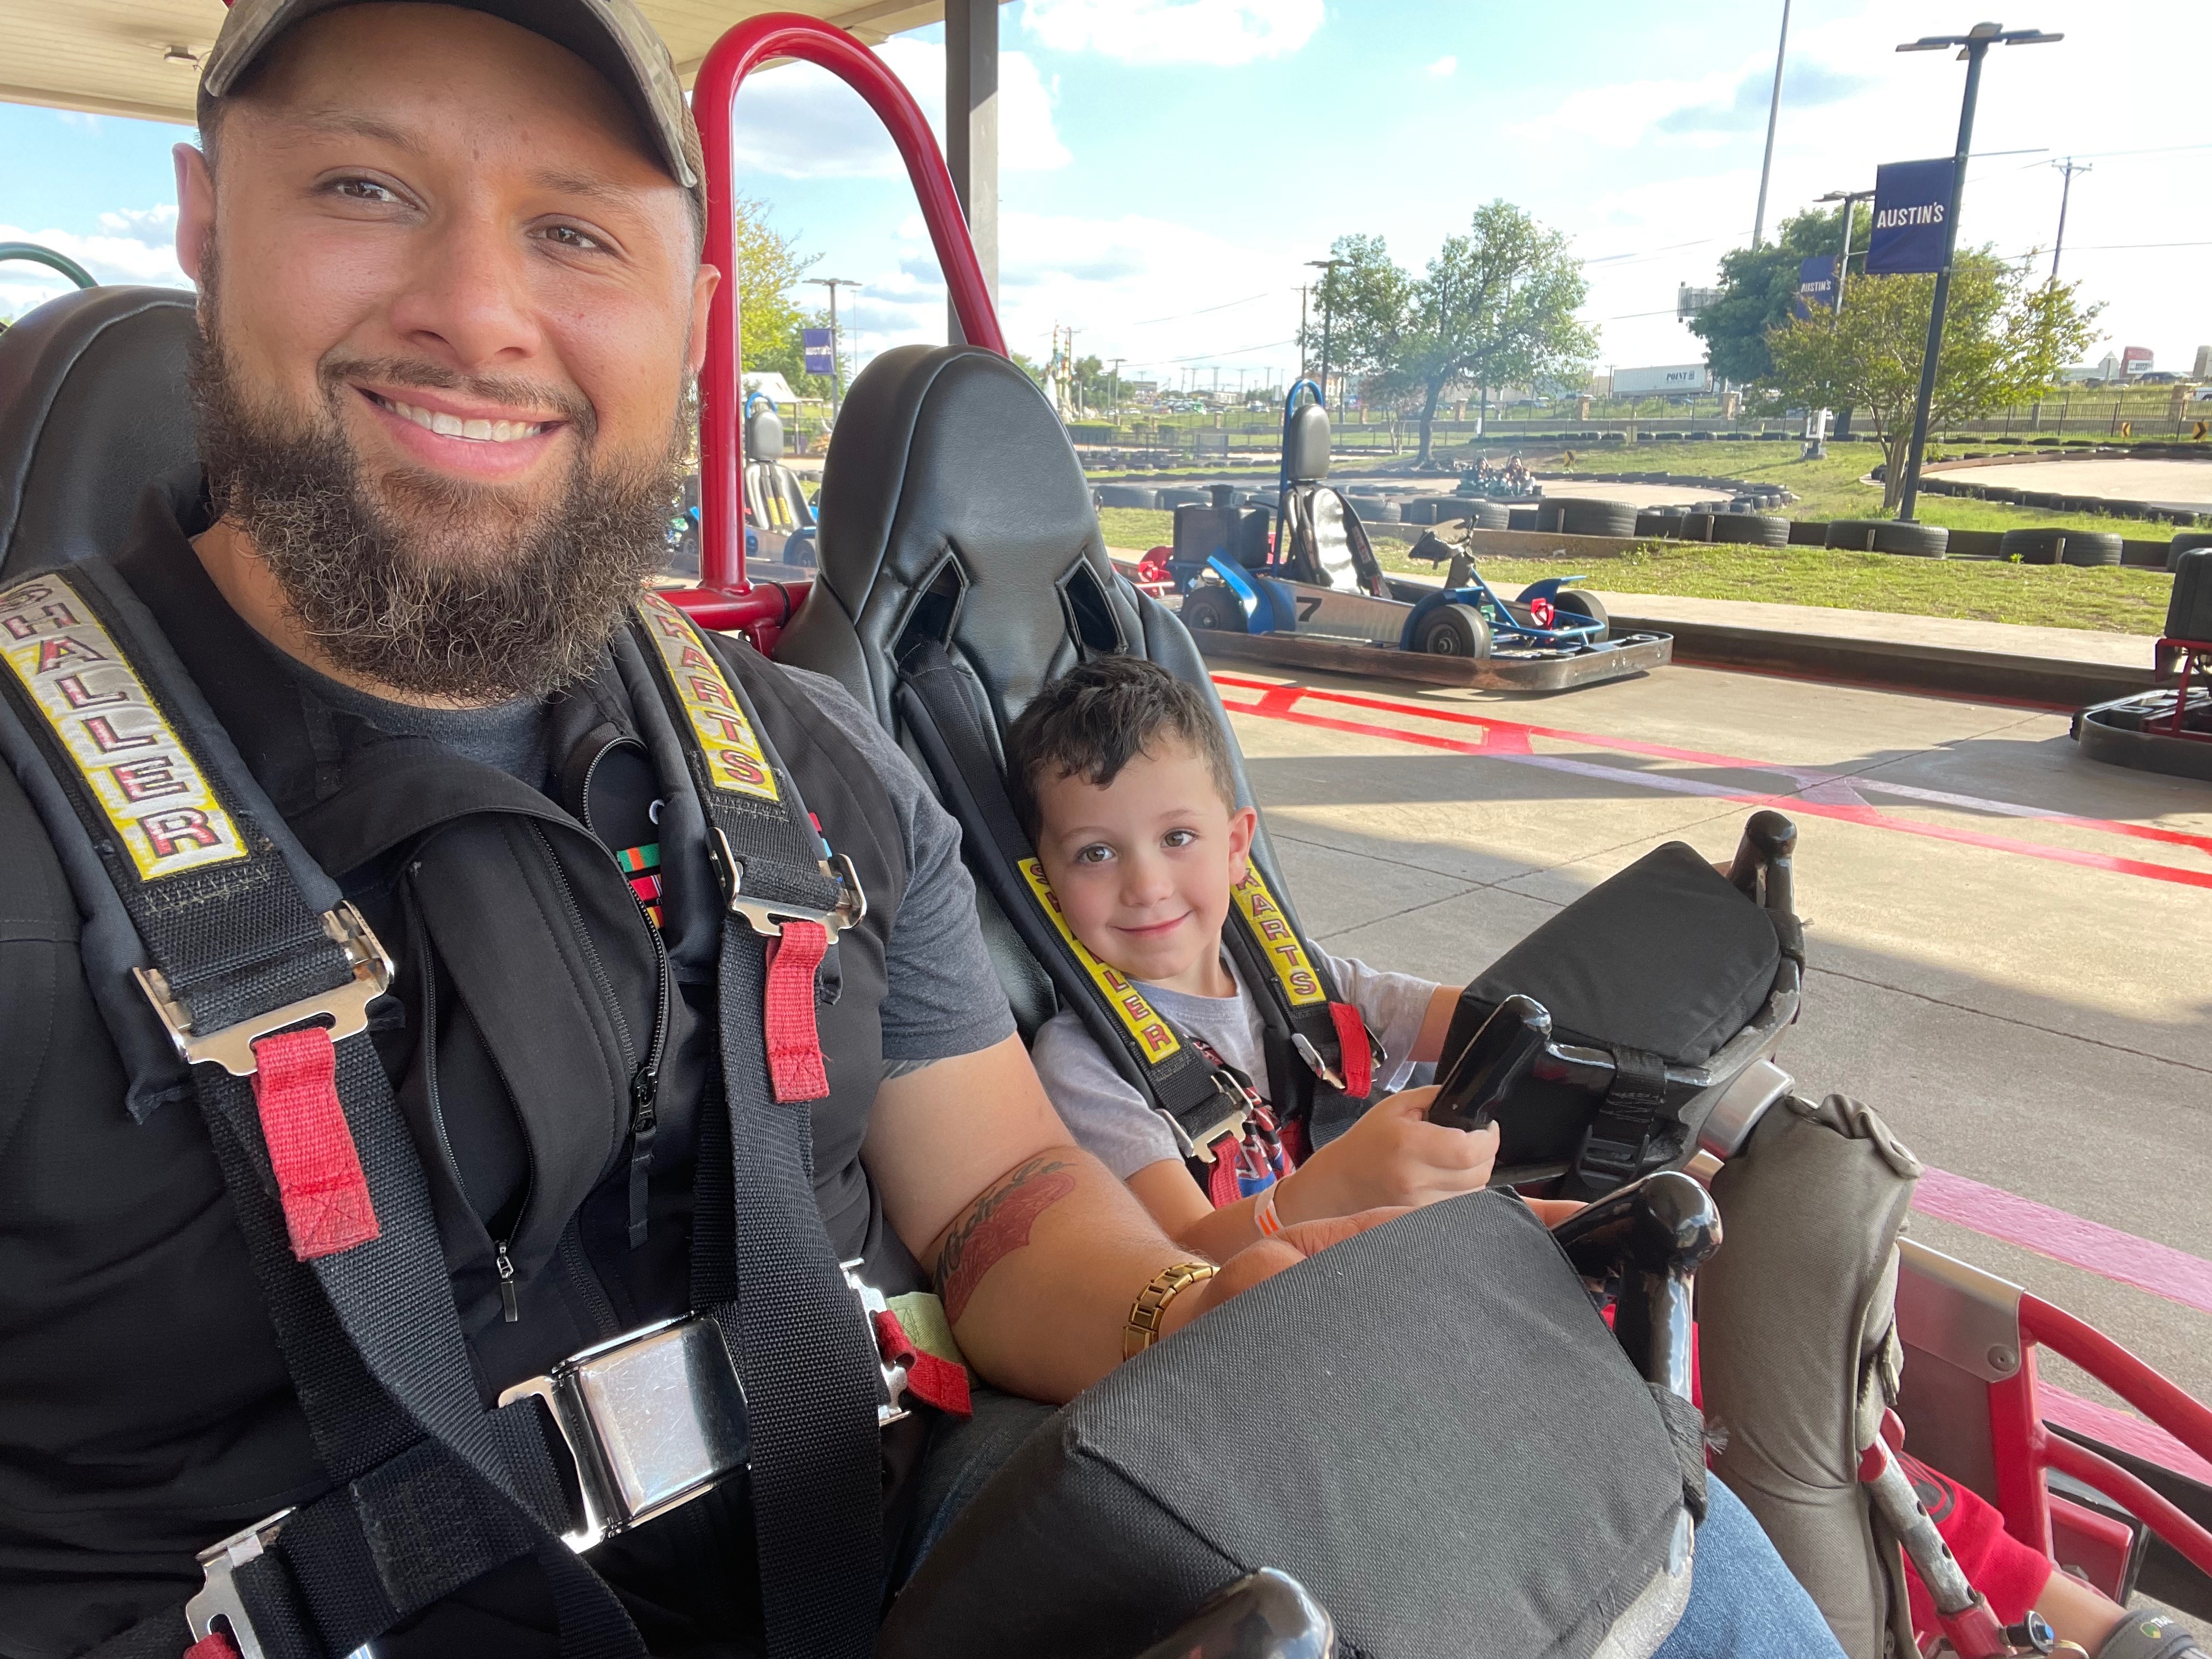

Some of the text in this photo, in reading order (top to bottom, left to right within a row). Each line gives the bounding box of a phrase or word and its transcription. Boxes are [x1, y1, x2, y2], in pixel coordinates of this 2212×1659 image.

[1877, 201, 1944, 228] AUSTIN'S
[1801, 279, 1832, 293] AUSTIN'S
[1666, 372, 1688, 381] POINT
[1295, 596, 1323, 623] 7
